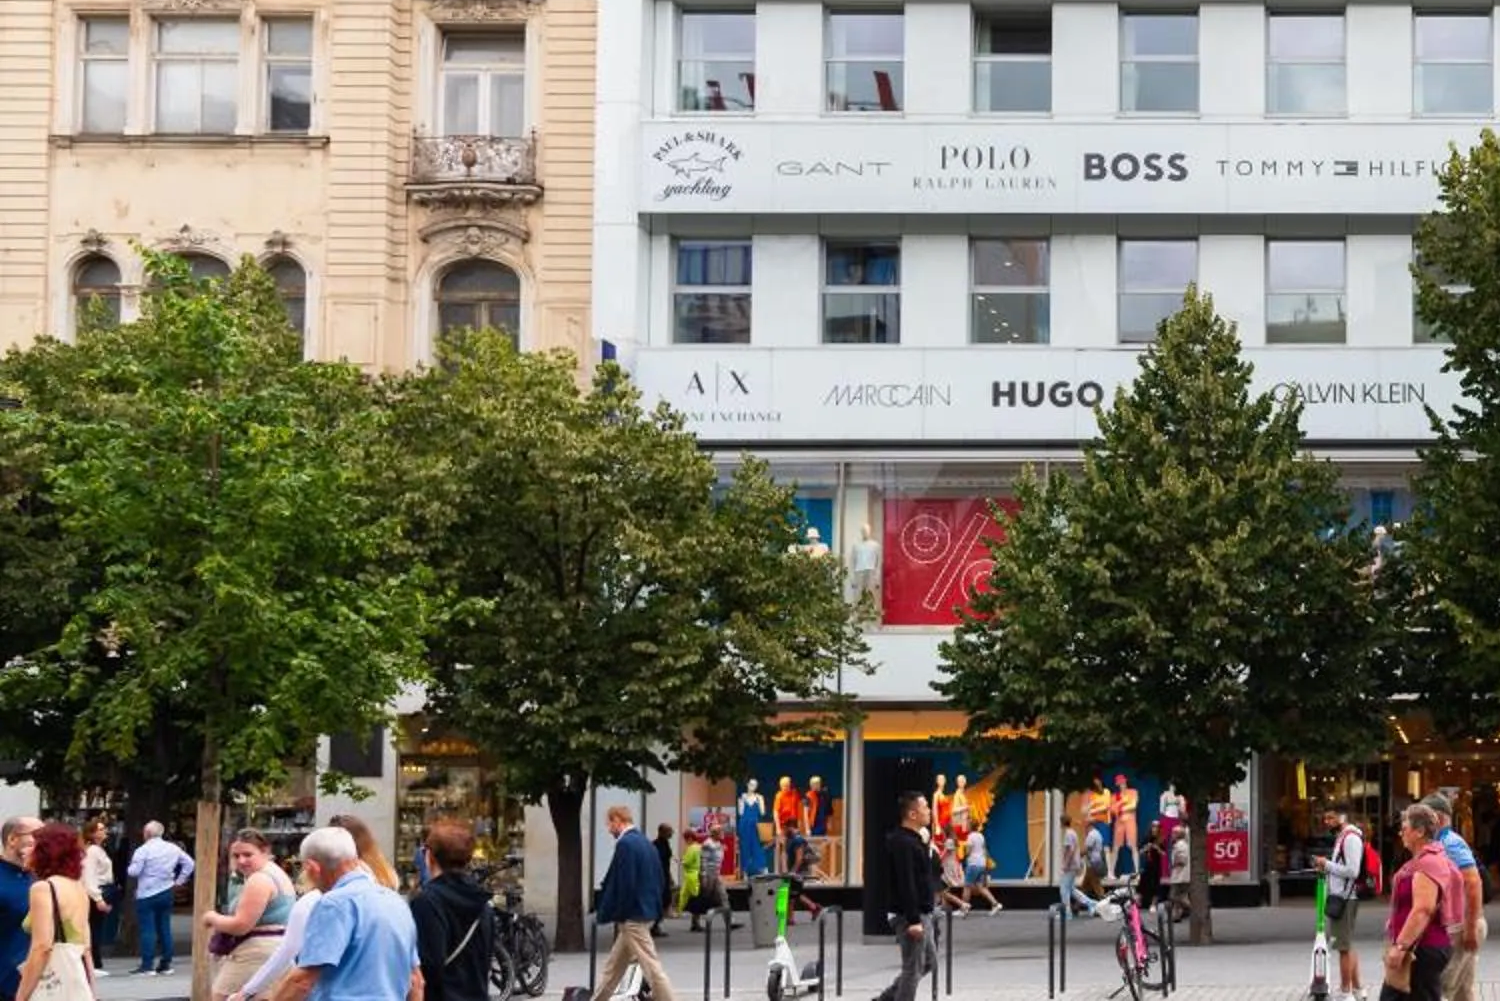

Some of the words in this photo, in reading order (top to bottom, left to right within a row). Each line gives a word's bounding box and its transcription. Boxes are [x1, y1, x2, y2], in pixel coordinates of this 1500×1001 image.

[652, 134, 683, 162] PAUL
[696, 131, 743, 162] SHARK
[940, 145, 1031, 170] POLO
[776, 161, 893, 177] GANT
[1083, 152, 1188, 182] BOSS
[1216, 160, 1324, 176] TOMMY
[913, 176, 973, 189] RALPH
[985, 176, 1057, 189] LAUREN
[991, 380, 1105, 408] HUGO
[1362, 381, 1425, 405] KLEIN
[711, 412, 783, 423] EXCHANGE
